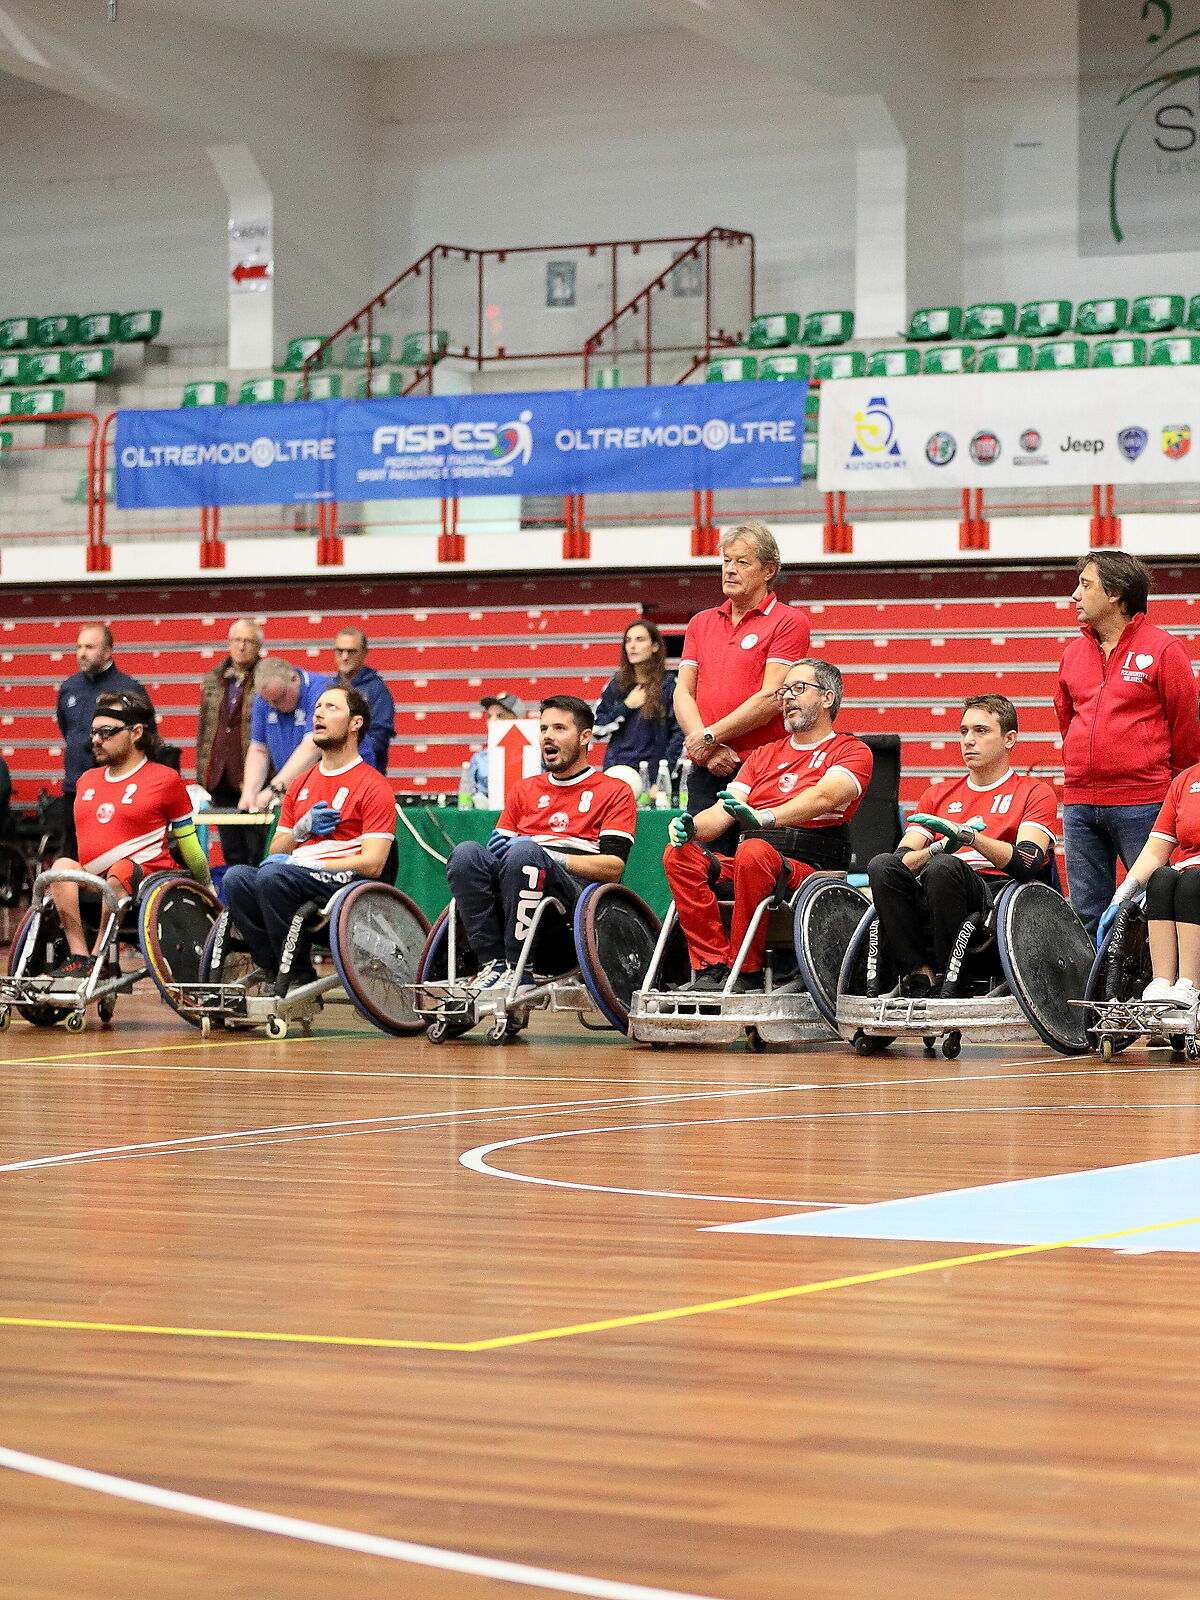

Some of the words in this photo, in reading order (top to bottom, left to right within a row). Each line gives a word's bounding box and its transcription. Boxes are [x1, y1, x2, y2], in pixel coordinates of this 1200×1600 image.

[372, 422, 499, 454] FISPES
[1060, 436, 1104, 455] Jeep
[844, 460, 907, 471] AUTONOMY
[1122, 651, 1136, 669] I
[121, 783, 138, 804] 2
[578, 790, 594, 813] 8
[990, 794, 1013, 814] 16
[515, 865, 546, 941] FILA
